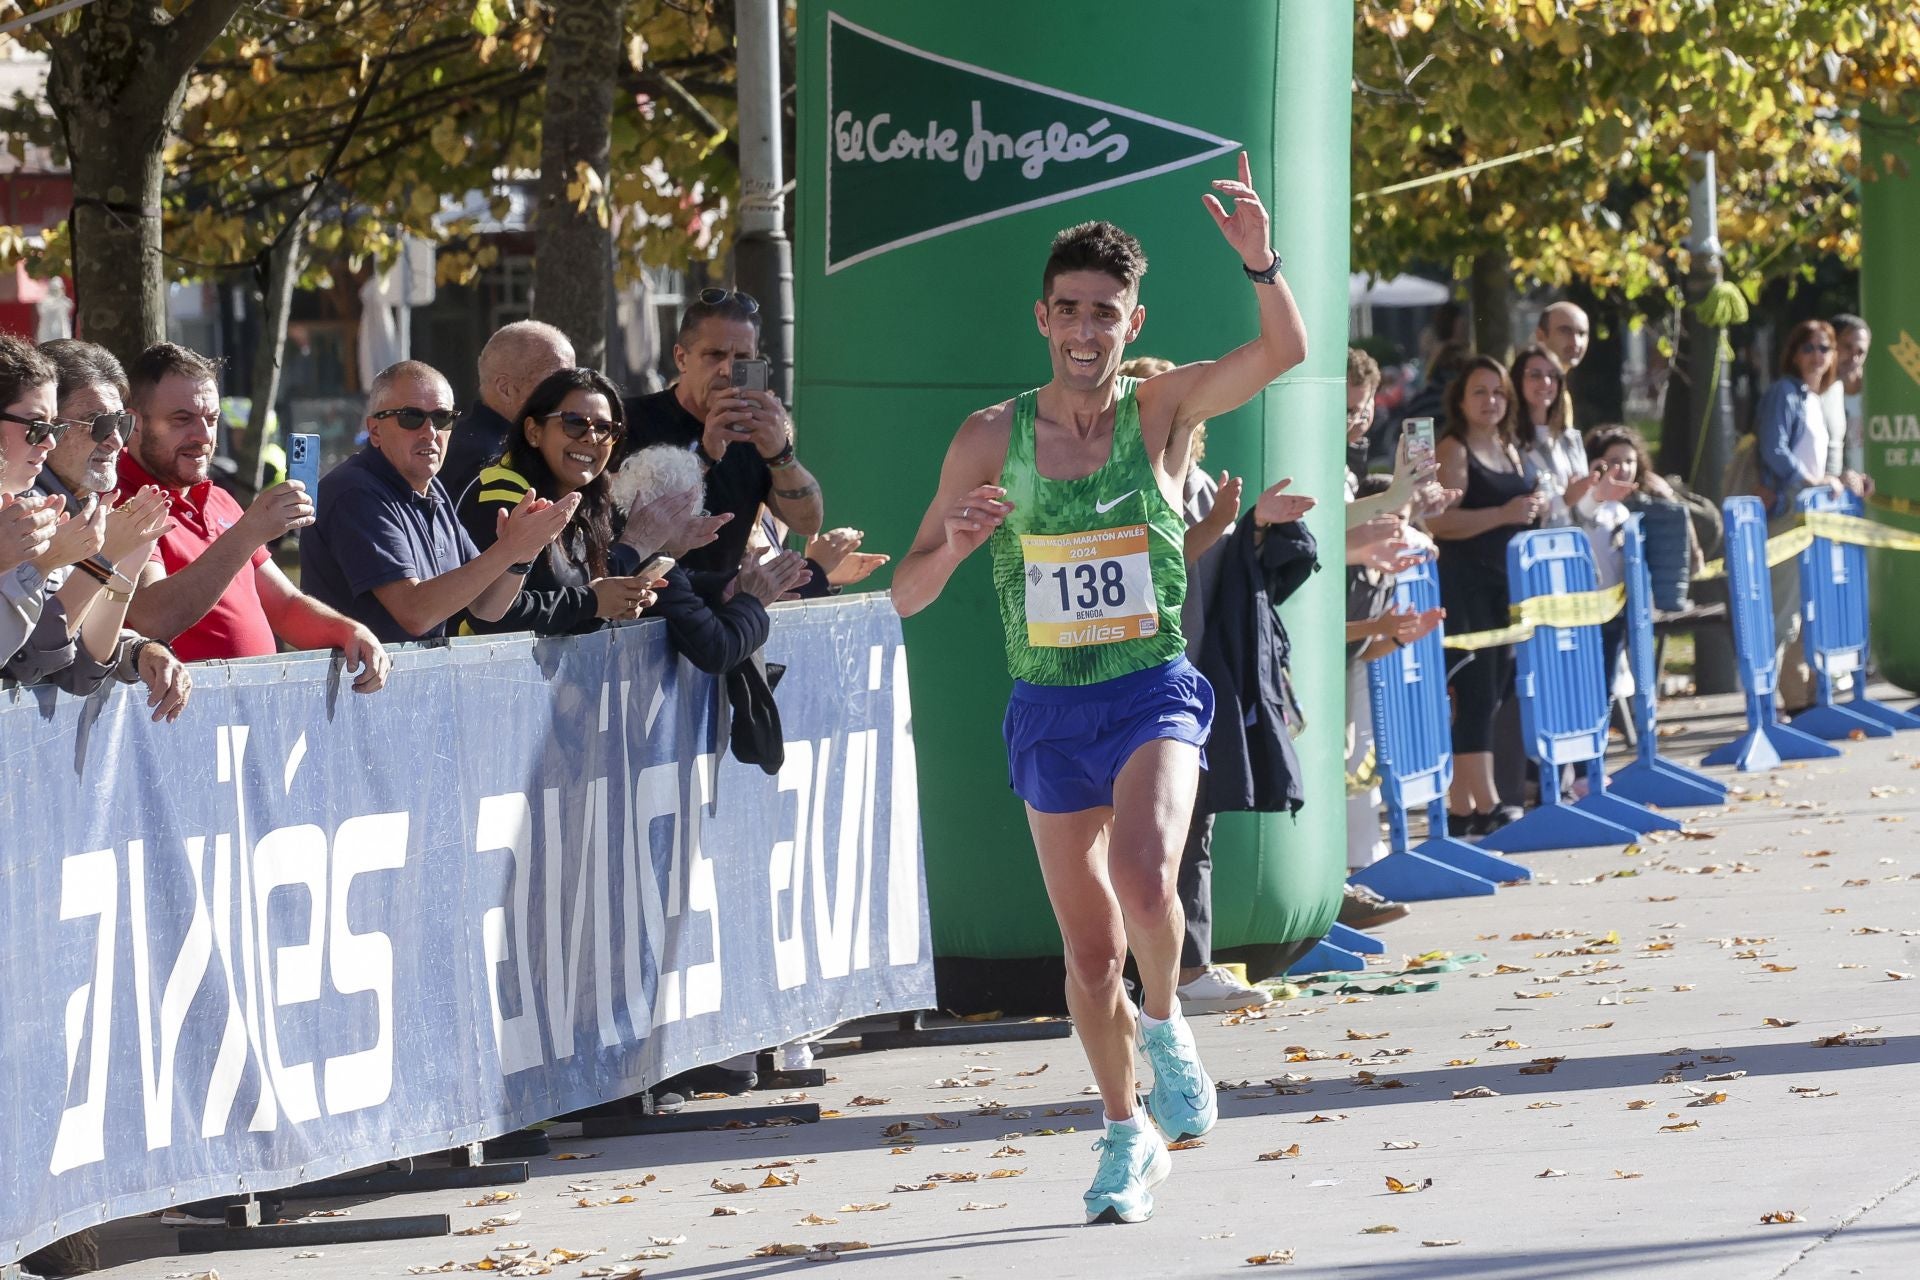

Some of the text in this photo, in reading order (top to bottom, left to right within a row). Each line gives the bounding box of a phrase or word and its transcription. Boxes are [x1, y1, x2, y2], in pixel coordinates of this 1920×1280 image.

[835, 100, 1129, 181] El Corte Inglés
[1869, 414, 1920, 443] CAJA
[1886, 448, 1908, 466] DE
[1073, 531, 1116, 545] MARATÓN
[1117, 528, 1145, 539] AVILÉS
[1070, 547, 1098, 558] 2024
[1052, 560, 1126, 611] 138
[1076, 608, 1104, 620] BENGOA
[1058, 624, 1126, 645] avilés
[476, 680, 723, 1076] avilés
[50, 725, 409, 1176] avilés
